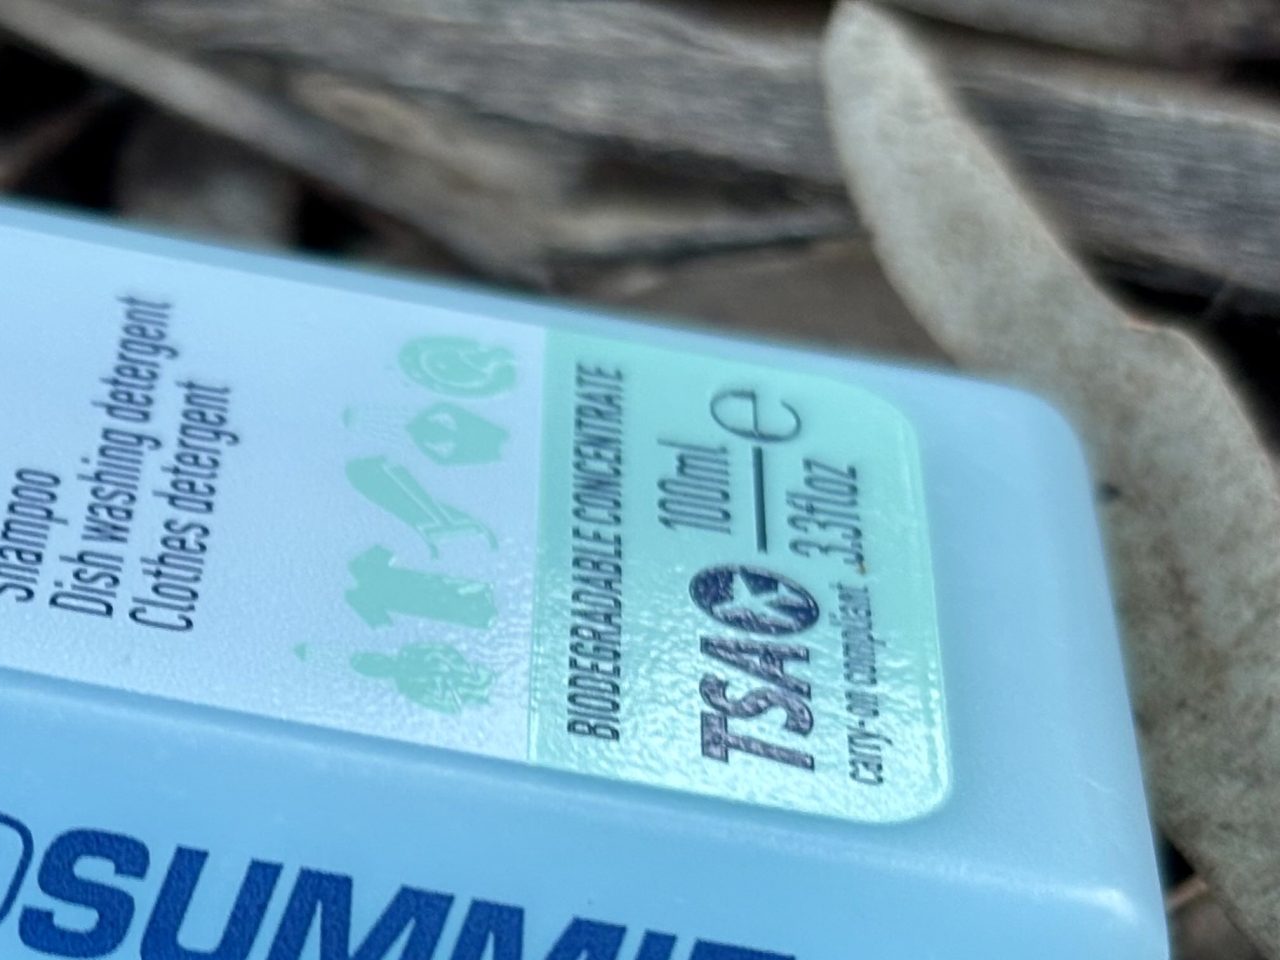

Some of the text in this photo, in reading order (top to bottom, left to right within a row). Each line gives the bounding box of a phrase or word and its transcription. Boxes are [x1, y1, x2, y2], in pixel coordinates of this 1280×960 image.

[48, 295, 179, 618] Dish washing detergent
[128, 380, 240, 633] Clothes detergent
[567, 361, 624, 742] BIODEGRADABLE CONCENTRATE
[656, 437, 732, 534] 100ml
[699, 636, 816, 772] TSA
[828, 582, 887, 684] compliant
